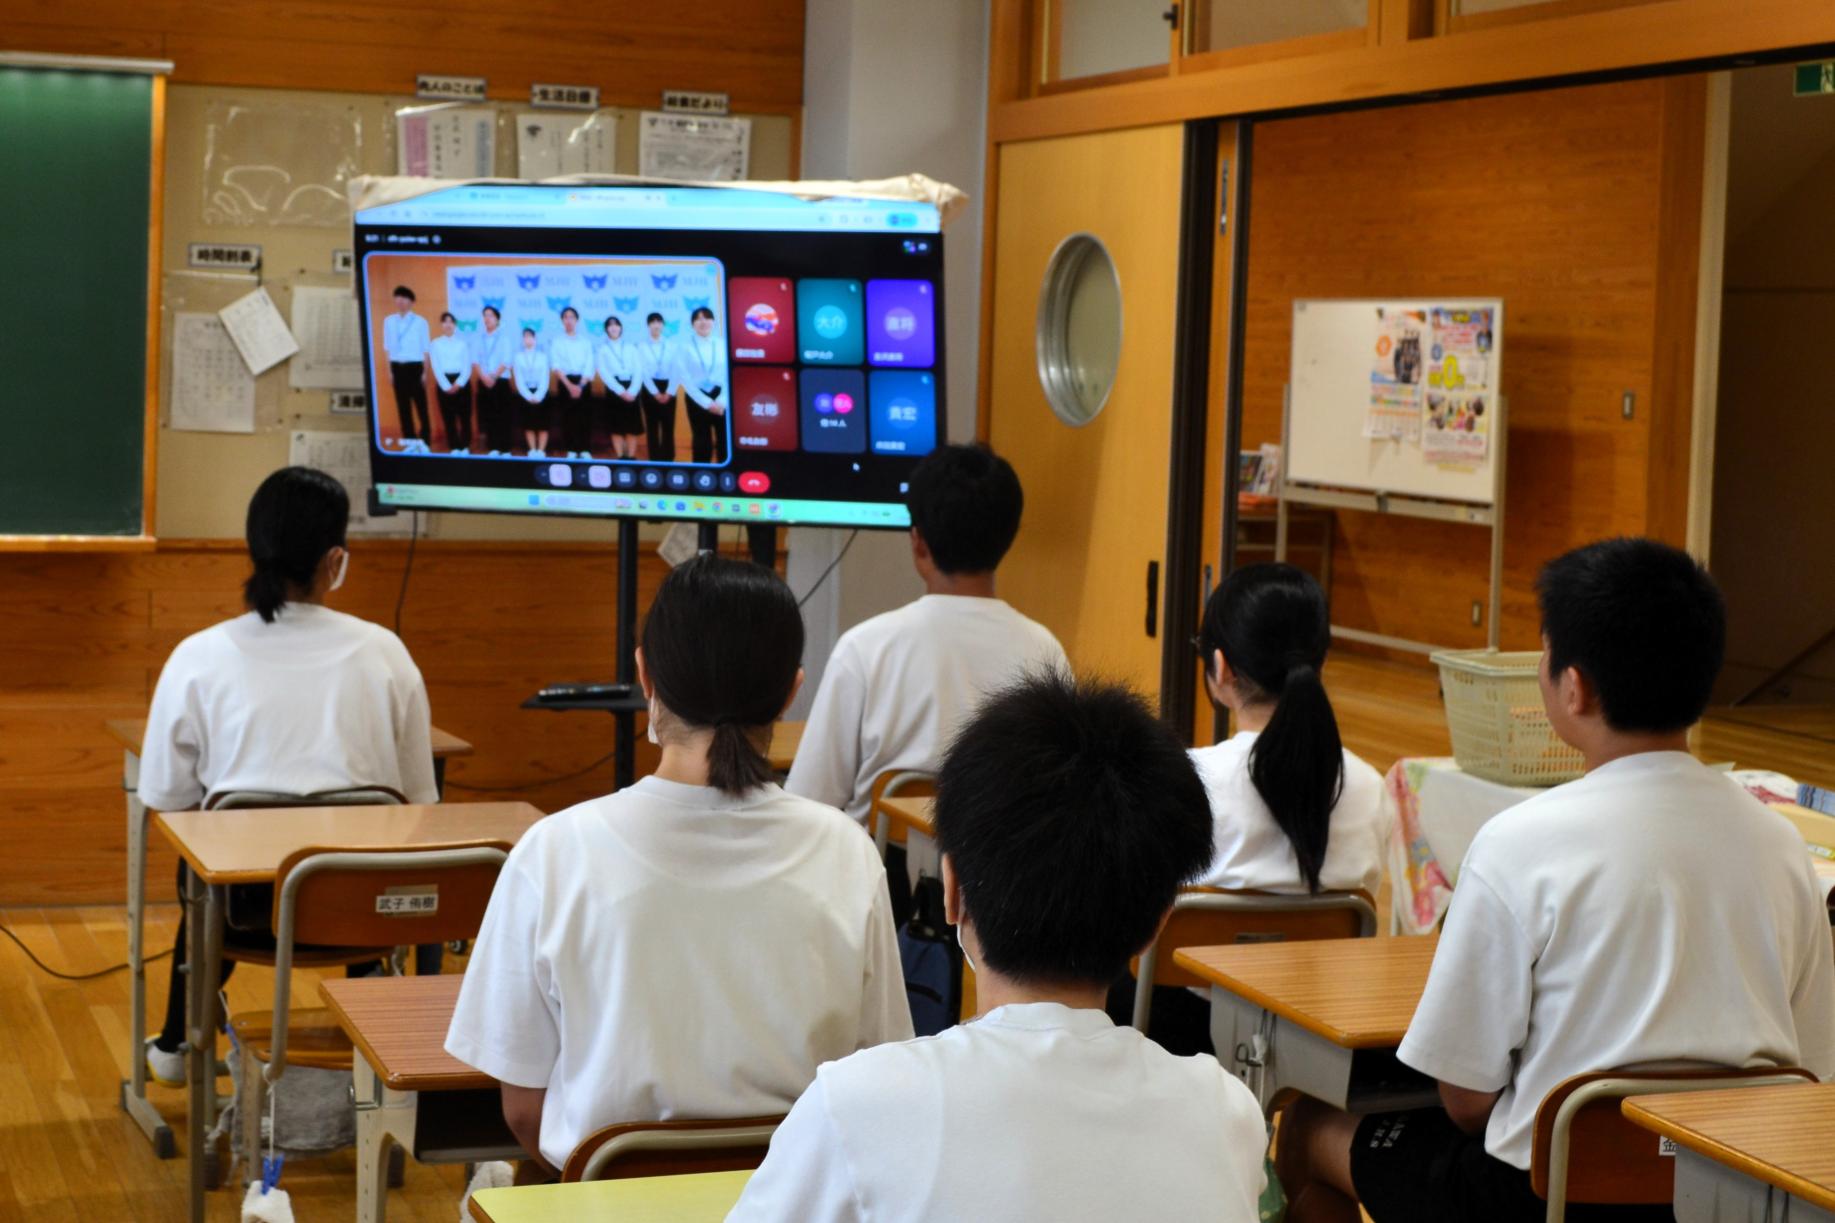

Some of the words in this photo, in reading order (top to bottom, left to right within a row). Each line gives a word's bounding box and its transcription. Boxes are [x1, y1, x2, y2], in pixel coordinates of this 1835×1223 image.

[538, 88, 591, 103] 生活目標
[197, 248, 252, 262] 時間割表
